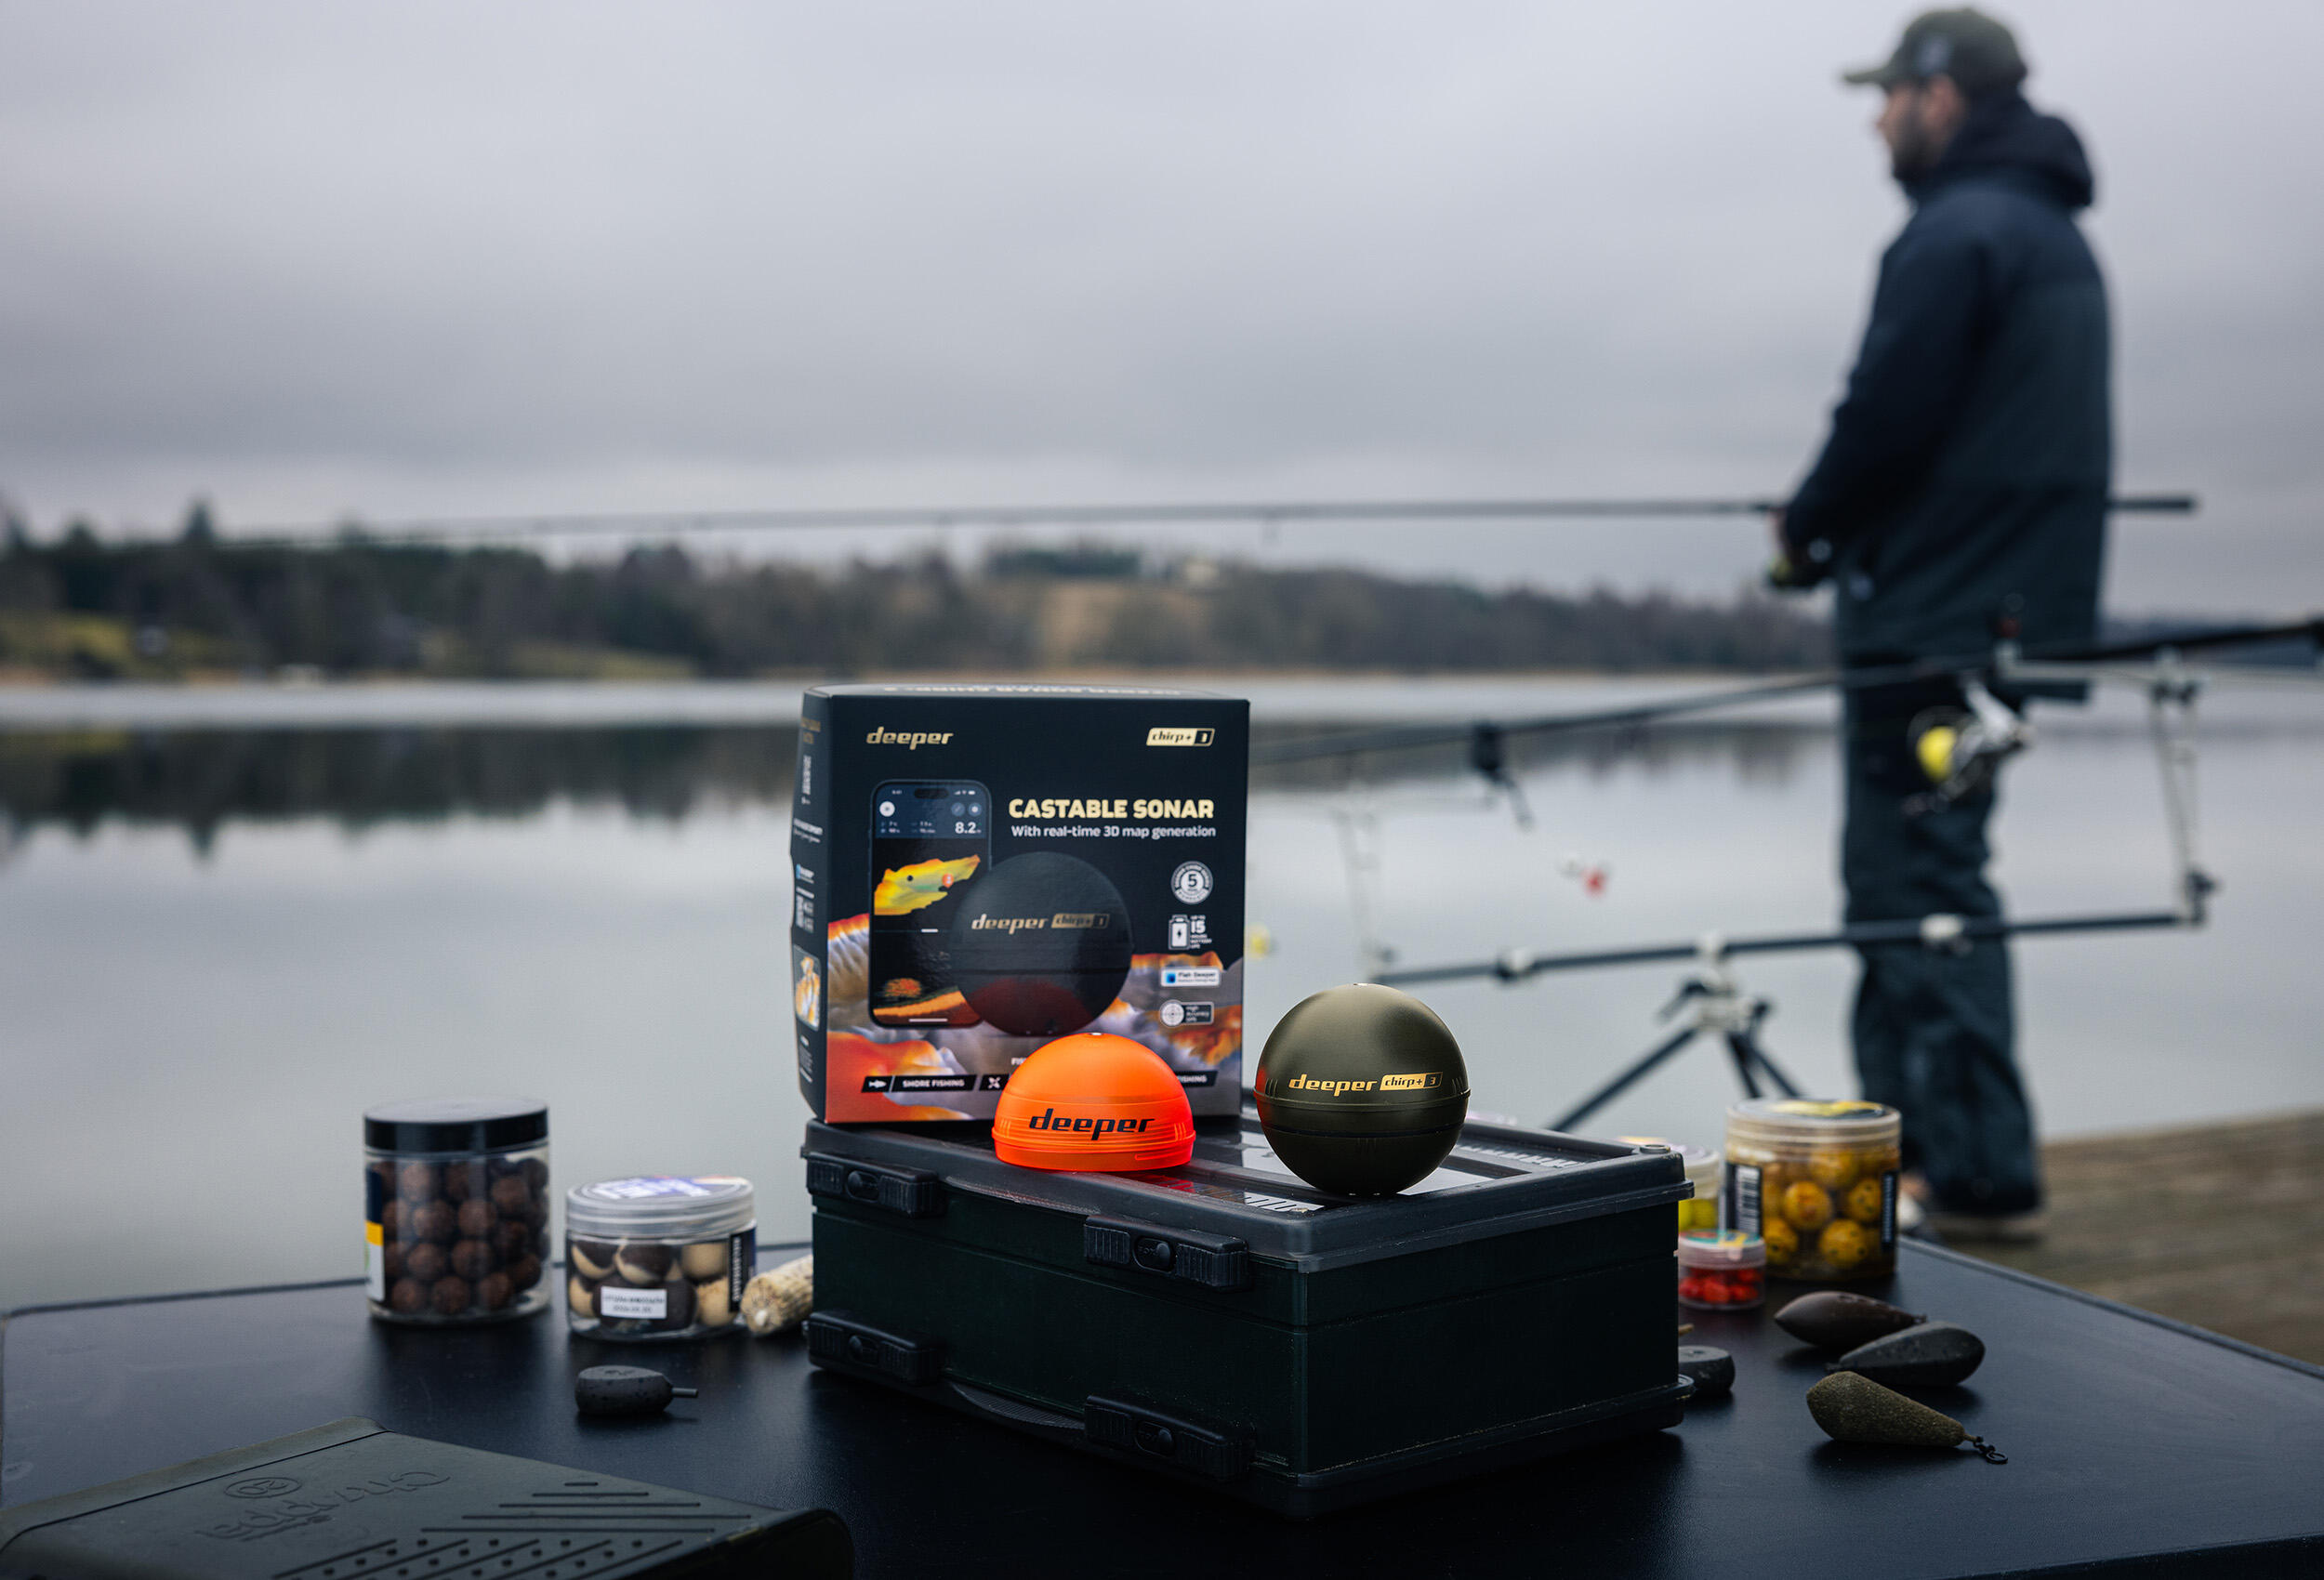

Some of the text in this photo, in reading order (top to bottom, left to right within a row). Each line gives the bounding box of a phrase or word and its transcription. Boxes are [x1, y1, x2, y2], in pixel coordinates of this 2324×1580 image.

[866, 726, 954, 750] deeper
[1009, 798, 1214, 819] CASTABLE SONAR
[1011, 825, 1216, 840] With real-time 3D map generation
[1187, 874, 1197, 888] 5
[971, 914, 1049, 935] deeper
[1191, 920, 1206, 934] 15
[931, 1079, 965, 1087] FISHING
[1288, 1073, 1378, 1097] deeper
[1384, 1074, 1422, 1087] chirp+
[1028, 1108, 1155, 1140] deeper
